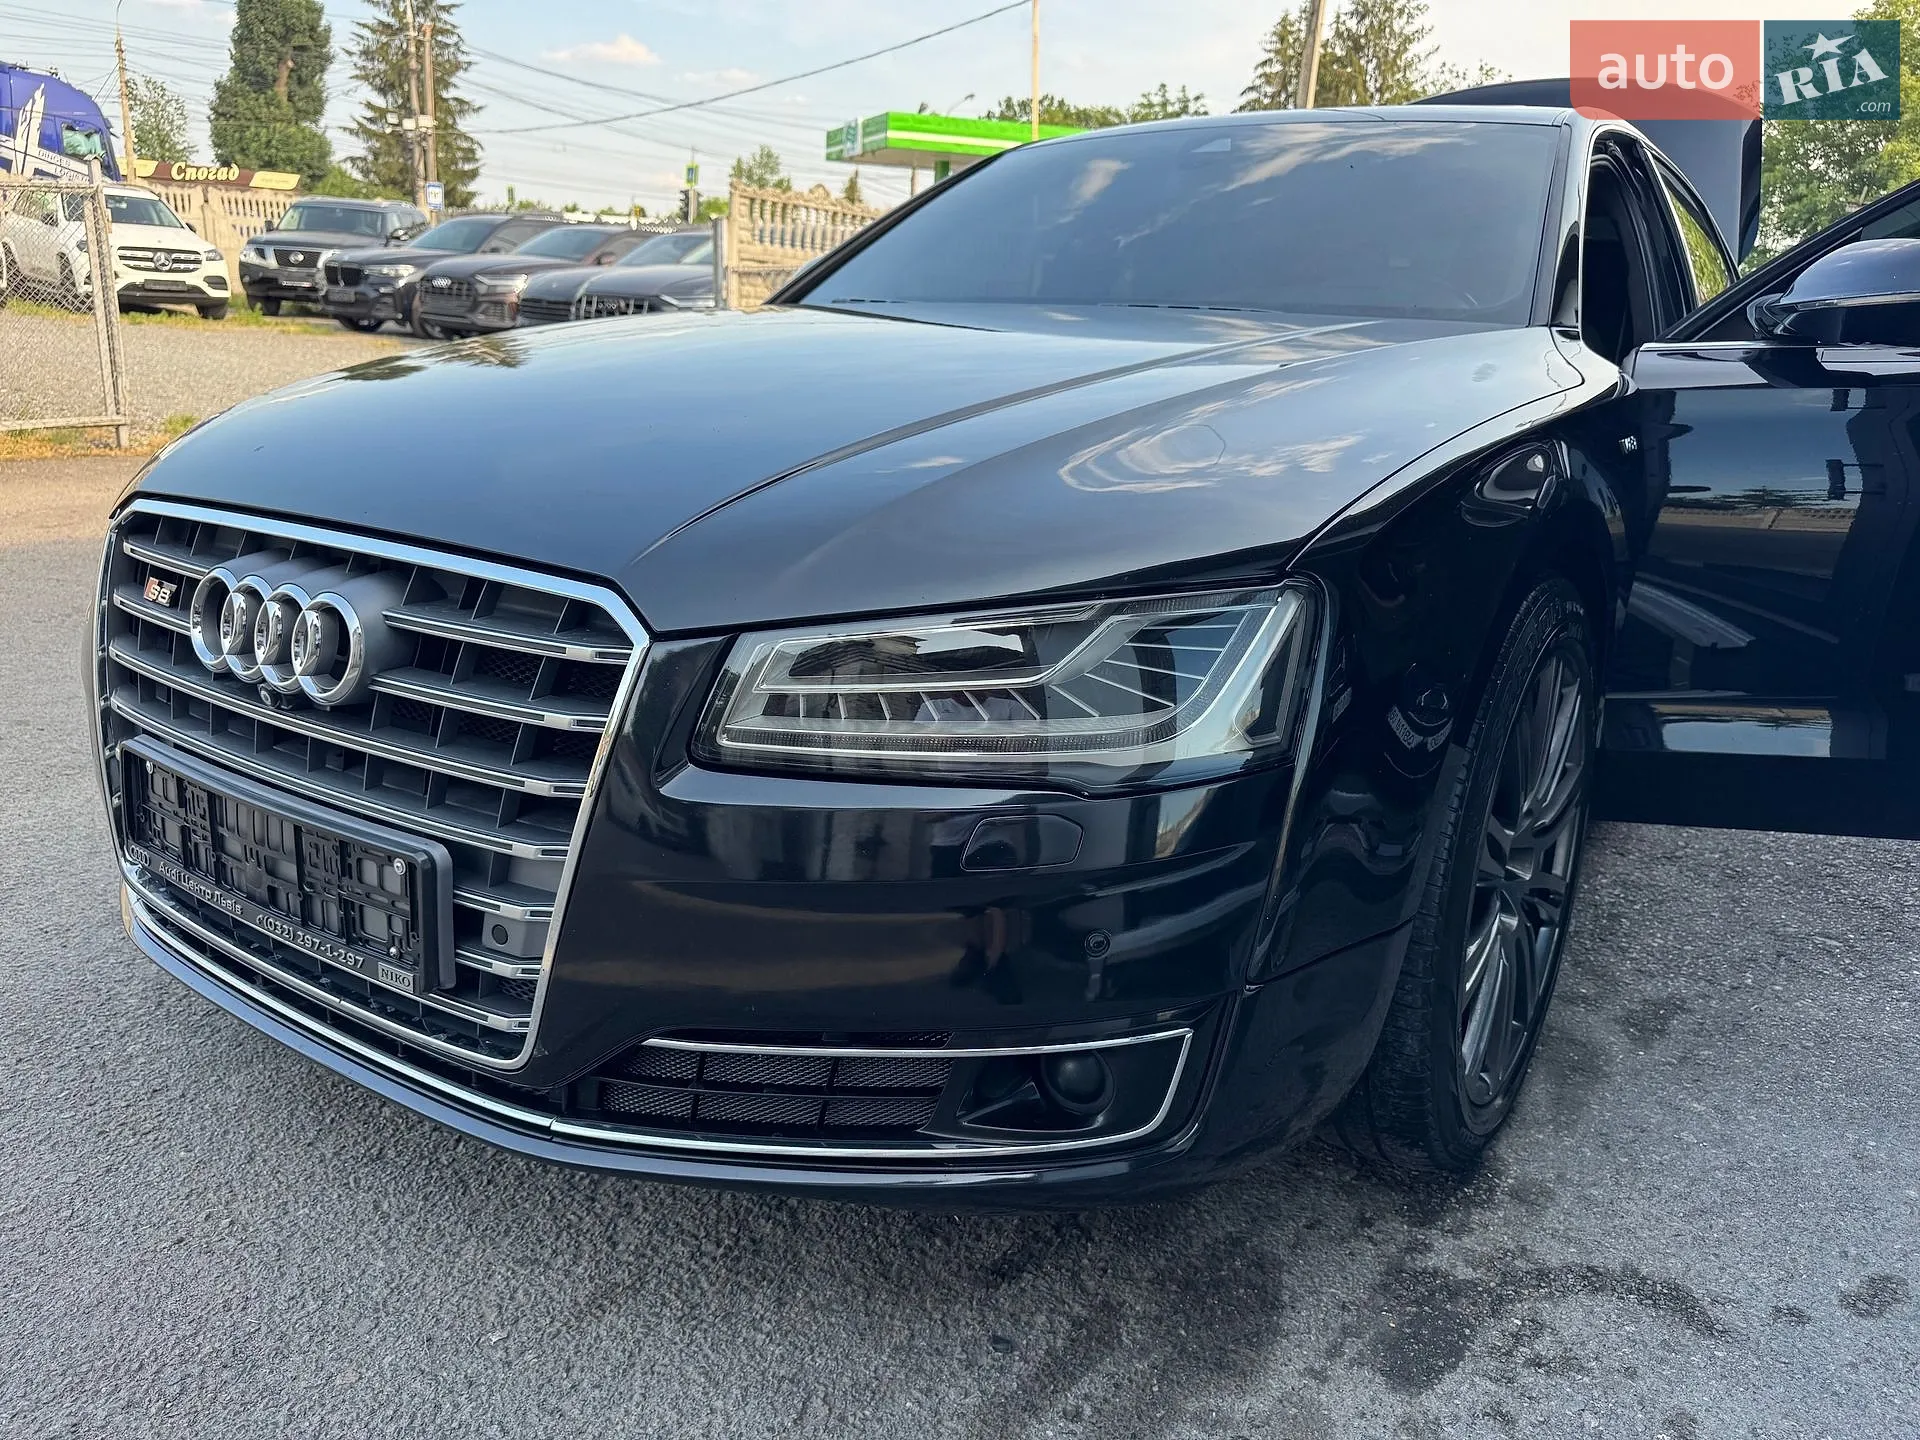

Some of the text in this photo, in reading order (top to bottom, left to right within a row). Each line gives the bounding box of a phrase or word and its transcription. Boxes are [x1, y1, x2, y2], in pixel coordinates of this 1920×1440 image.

[170, 162, 240, 181] Спогад
[148, 583, 171, 604] S8
[158, 861, 243, 915] Audi Центр Львів
[263, 914, 365, 969] (032) 297-1-297
[380, 967, 412, 988] NIKO
